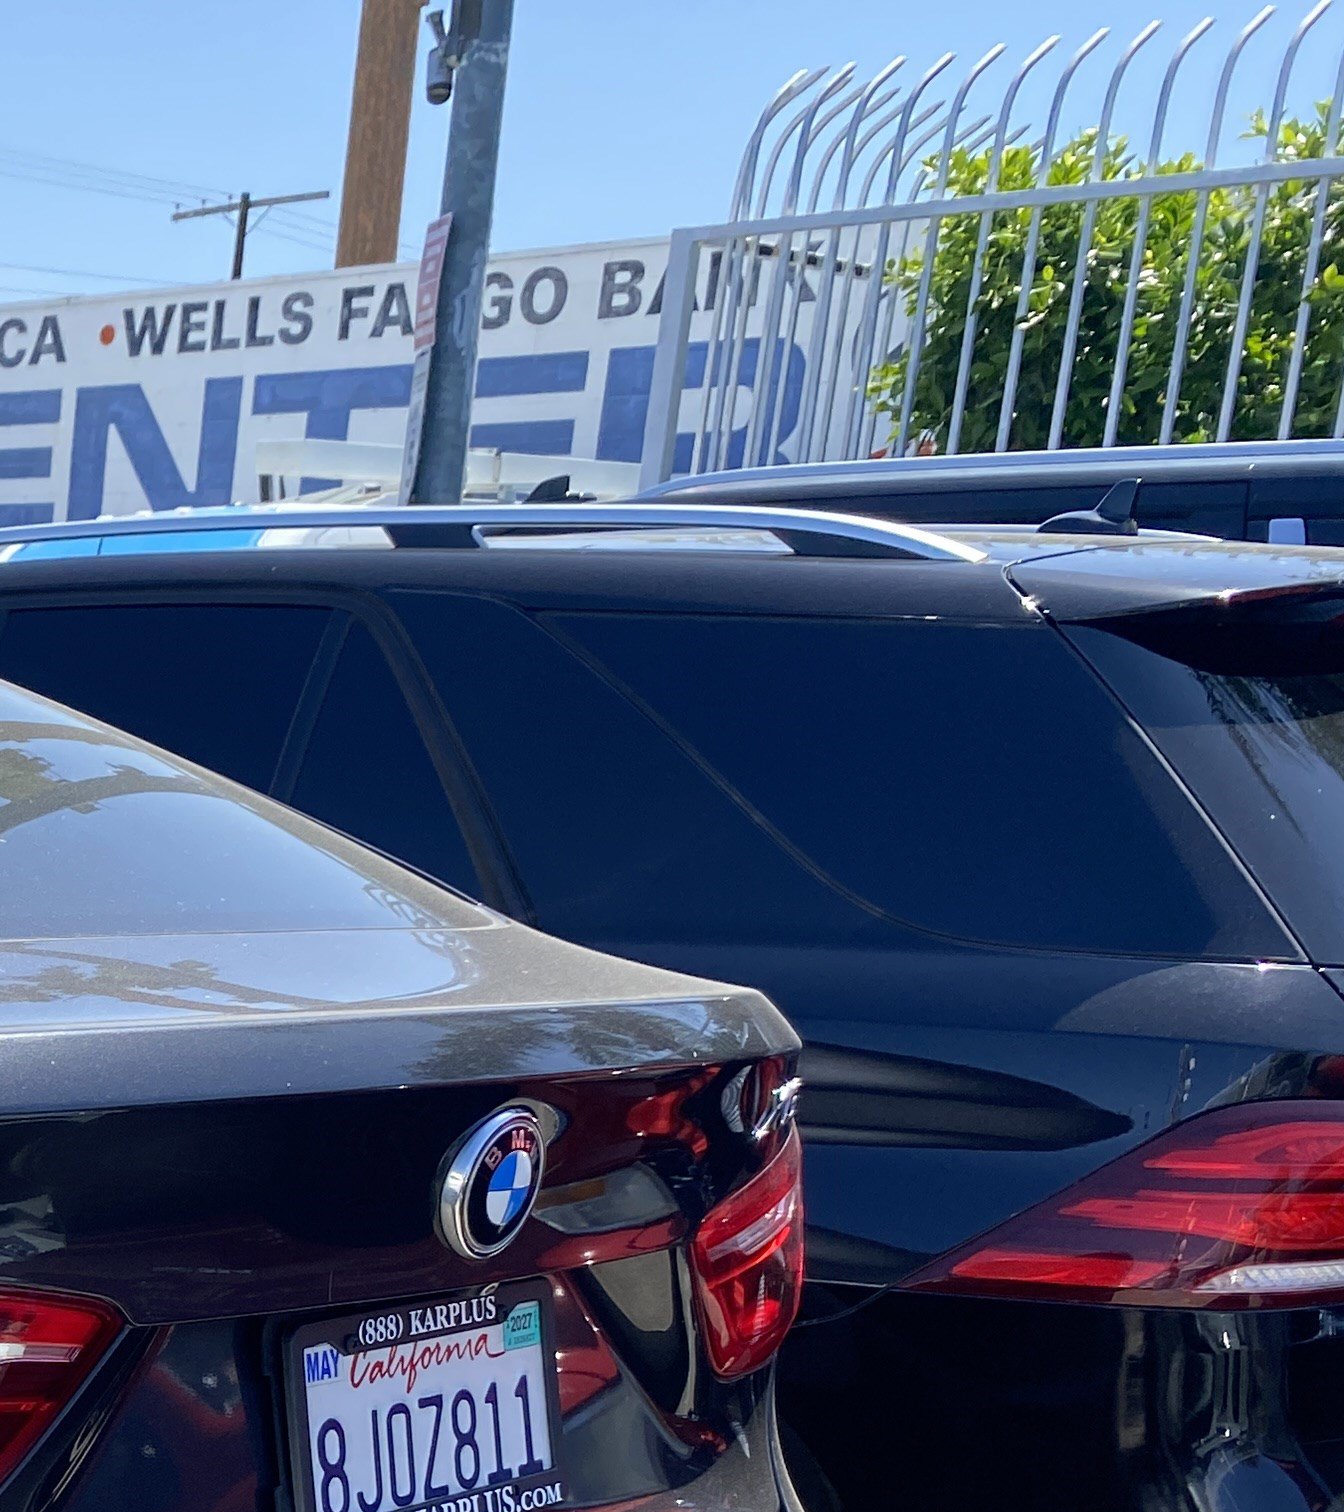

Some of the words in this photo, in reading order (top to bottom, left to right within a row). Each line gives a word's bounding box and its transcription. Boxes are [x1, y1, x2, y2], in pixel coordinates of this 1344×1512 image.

[123, 291, 314, 358] WELLS
[337, 265, 568, 341] FAGO
[358, 1313, 404, 1346] (888)
[409, 1296, 496, 1336] KARPLUS
[306, 1349, 339, 1383] MAY
[350, 1333, 506, 1394] California
